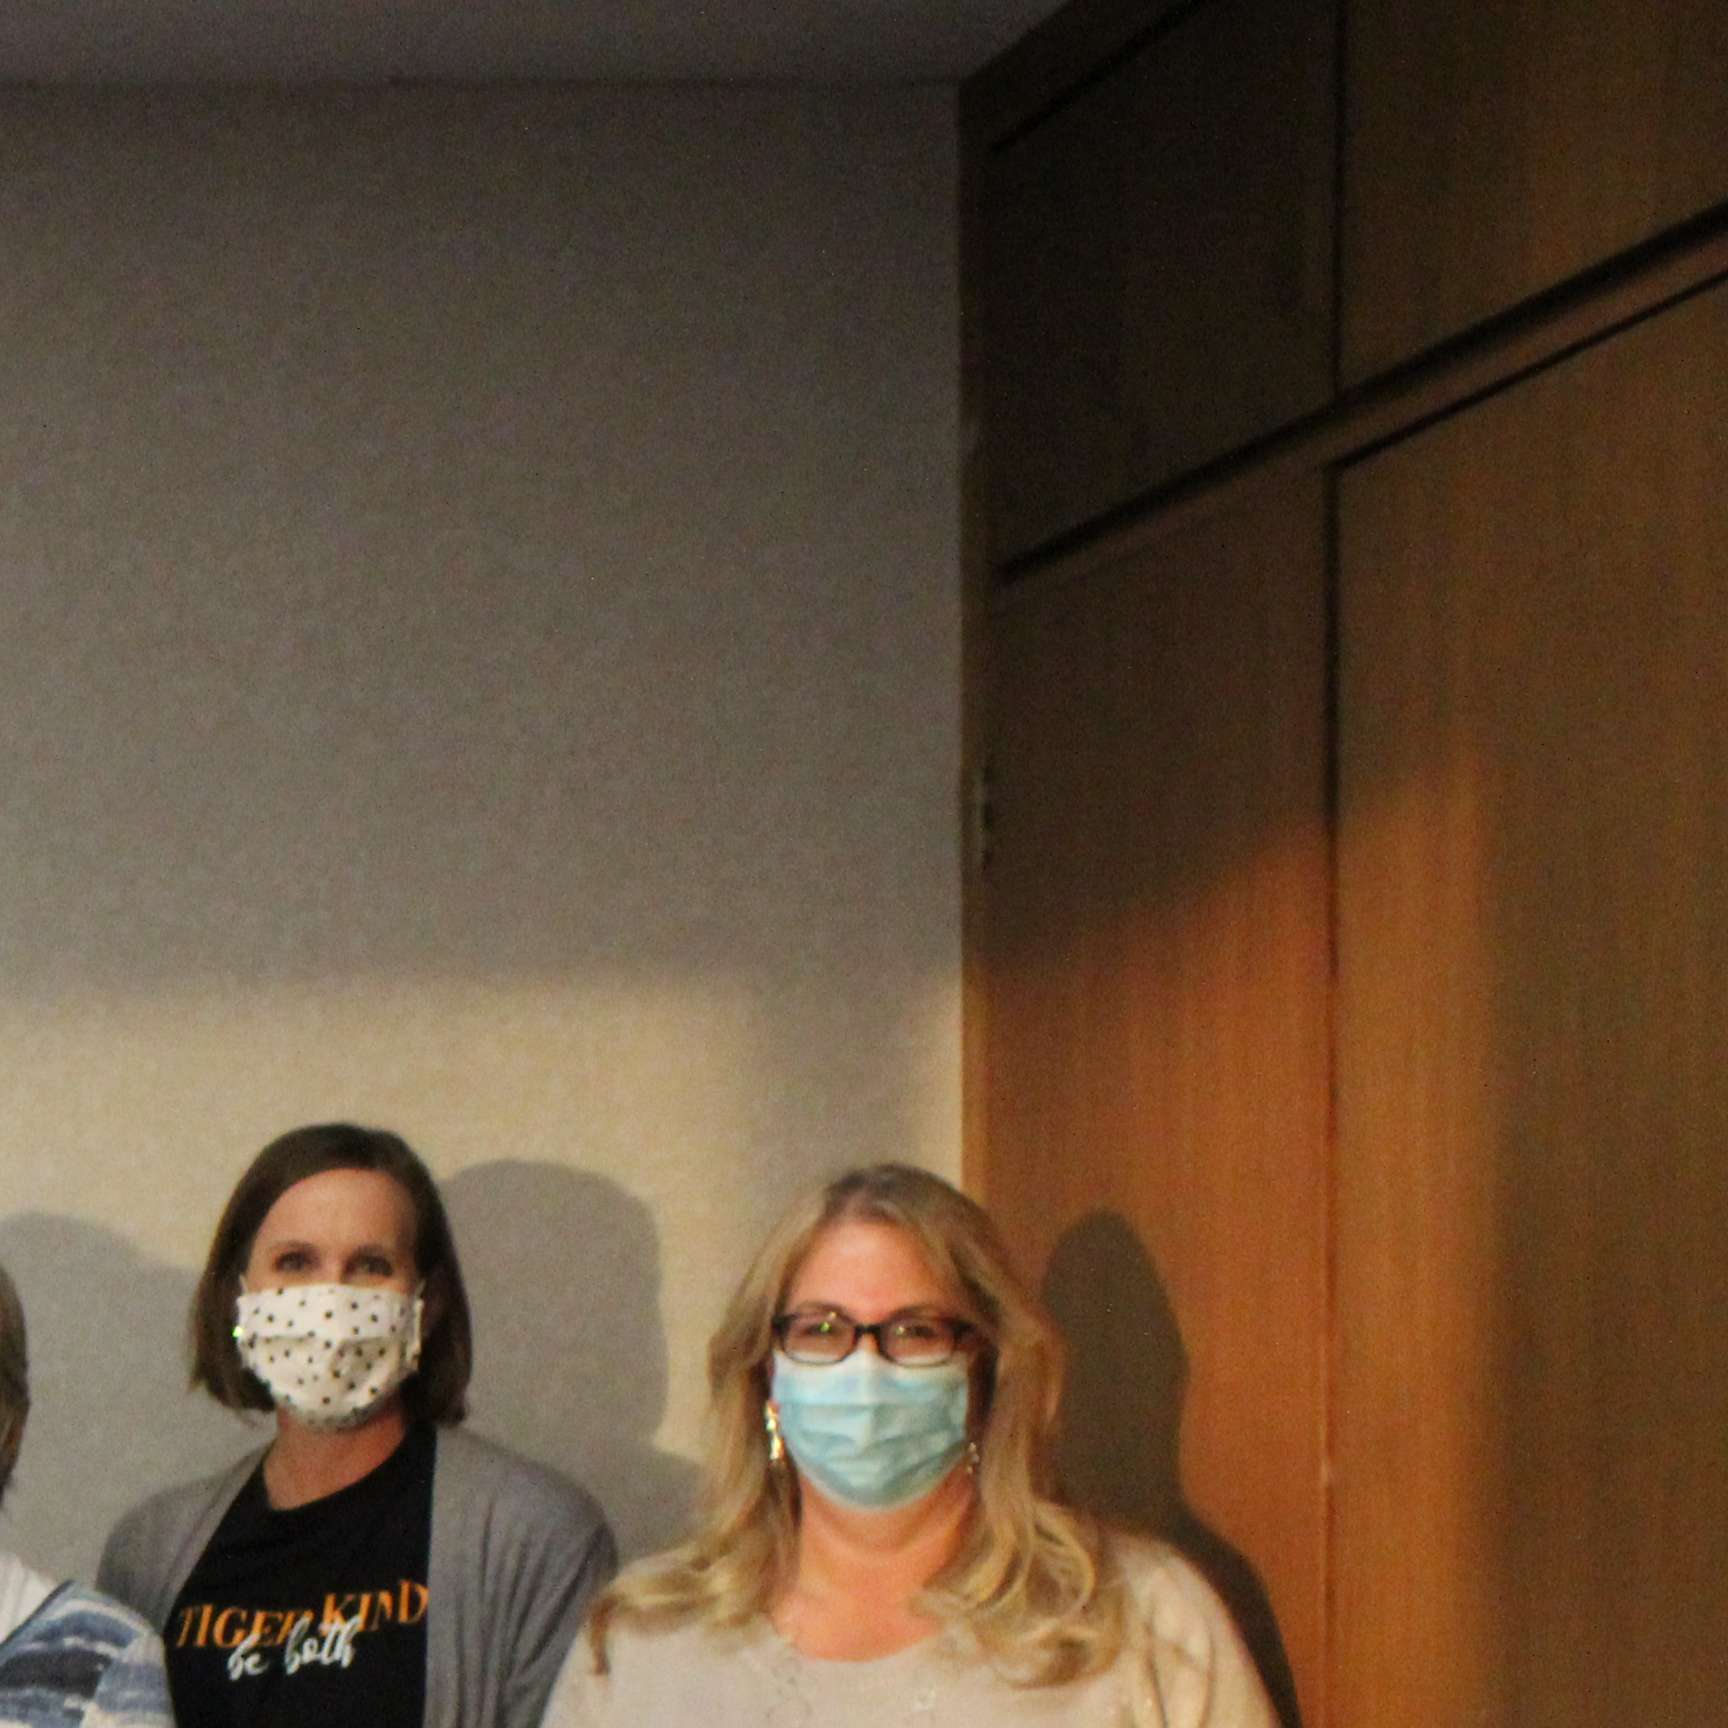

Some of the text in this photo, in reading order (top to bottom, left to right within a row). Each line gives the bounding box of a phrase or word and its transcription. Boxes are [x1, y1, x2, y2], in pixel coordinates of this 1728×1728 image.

[318, 1577, 429, 1634] KIND
[226, 1613, 359, 1681] be both
